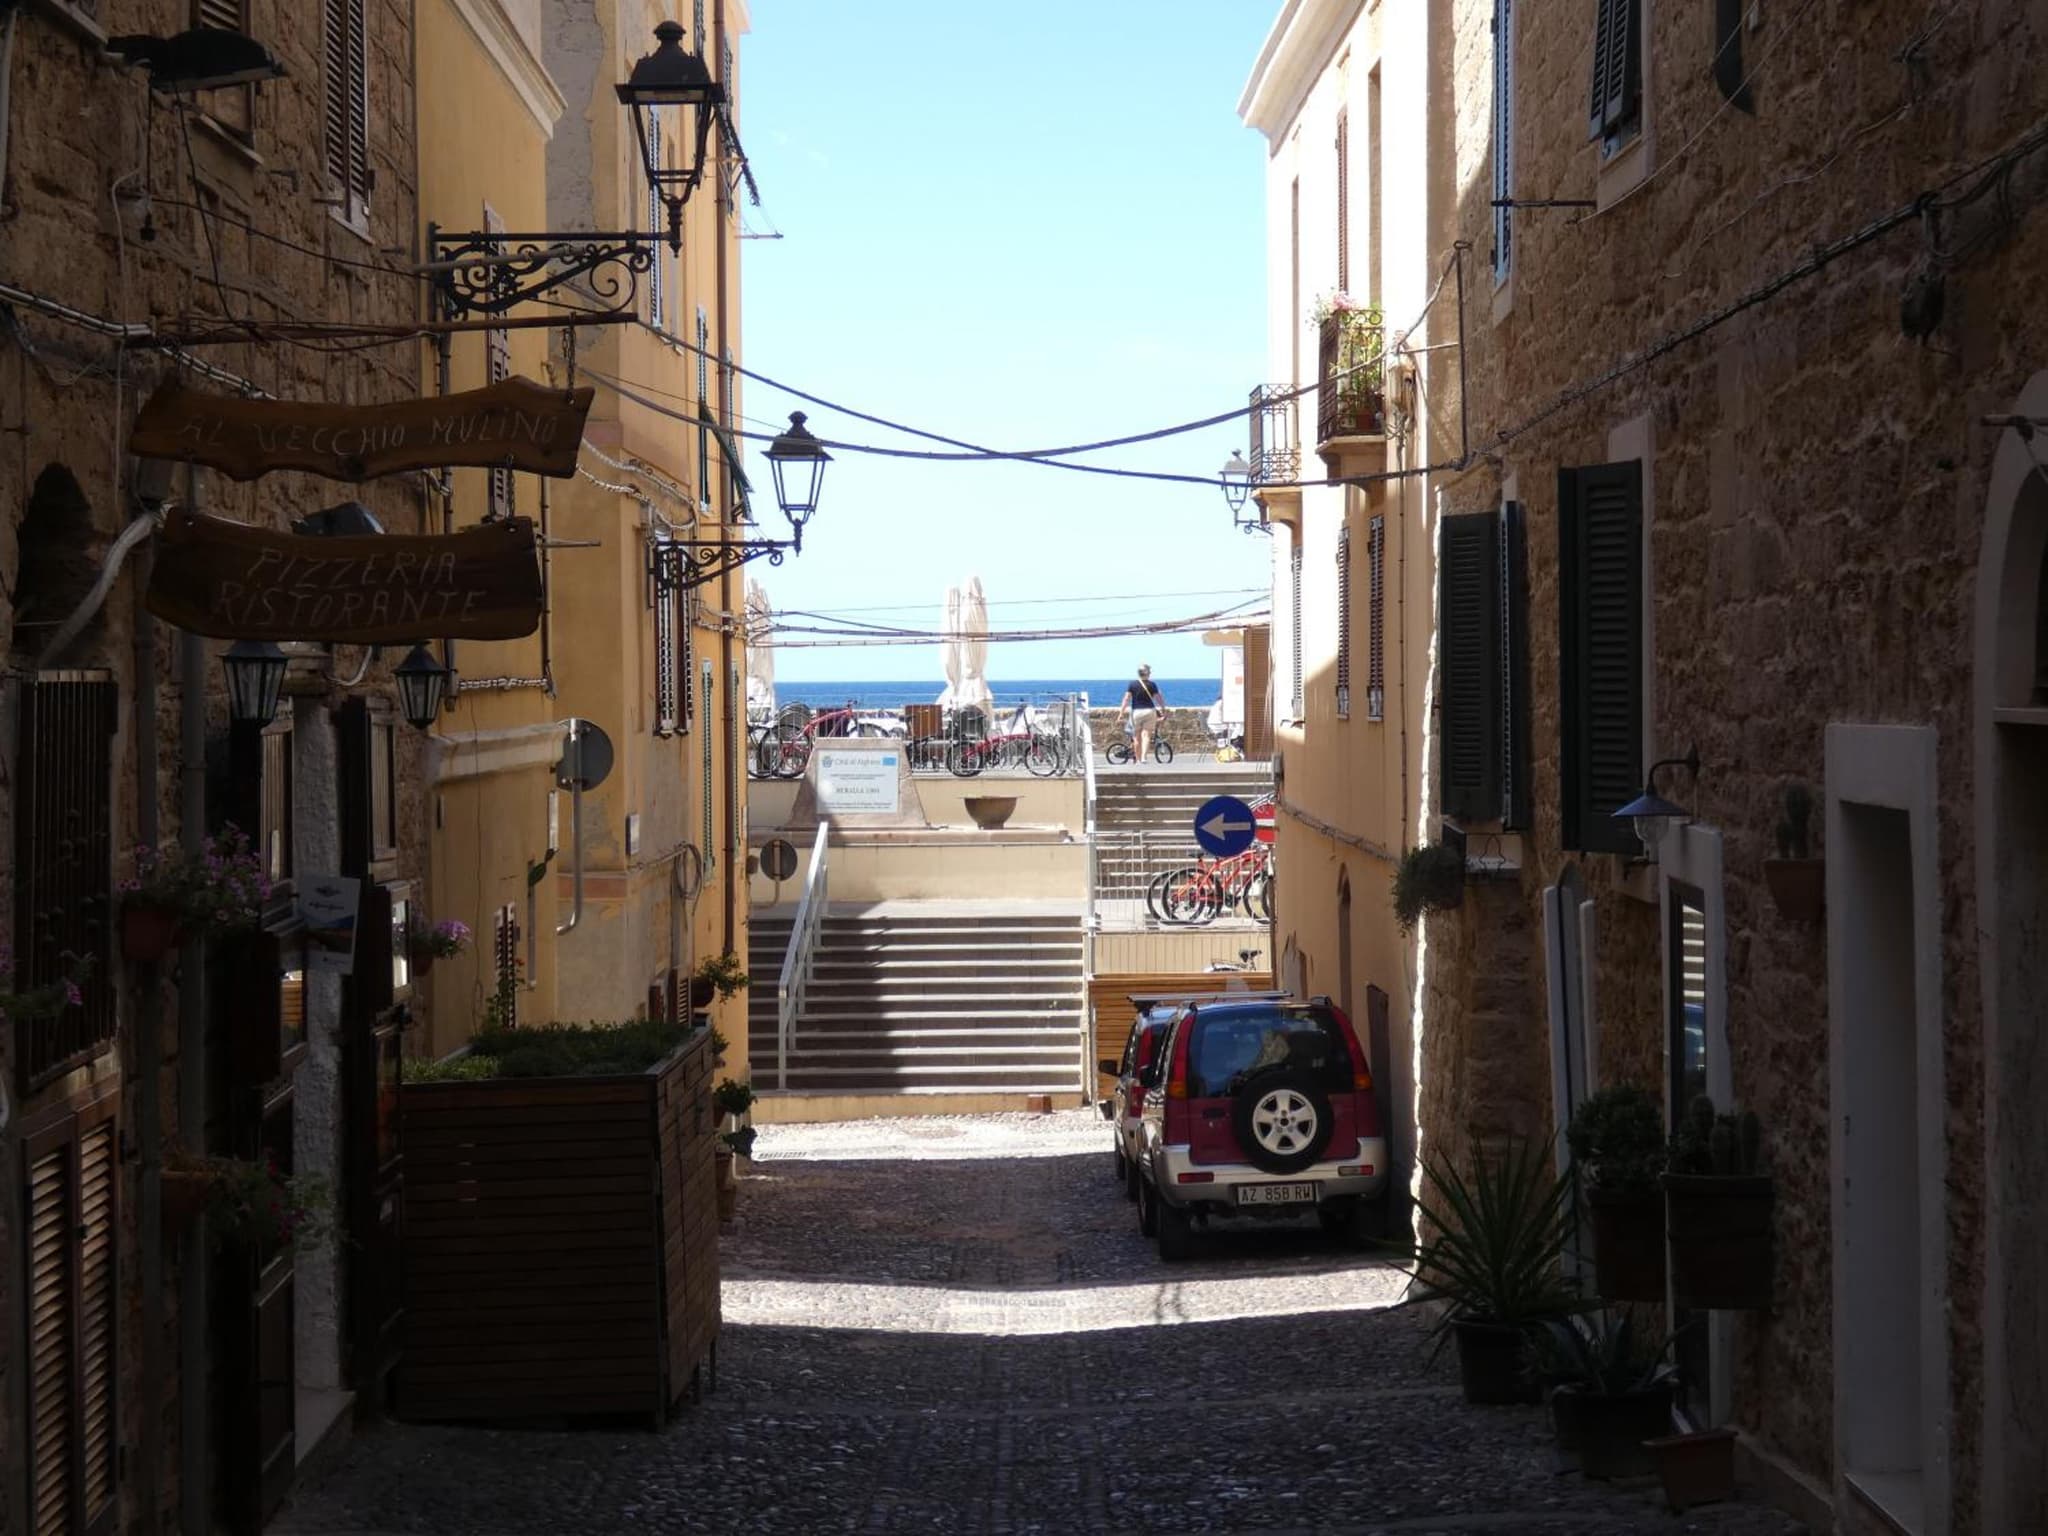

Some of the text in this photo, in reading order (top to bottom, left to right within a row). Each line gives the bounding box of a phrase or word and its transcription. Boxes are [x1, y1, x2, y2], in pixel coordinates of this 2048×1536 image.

[178, 415, 225, 447] AL
[253, 423, 407, 457] VECCHIO
[246, 547, 458, 590] PIZZERIA
[212, 579, 488, 627] RISTORANTE
[1242, 1188, 1257, 1202] AZ
